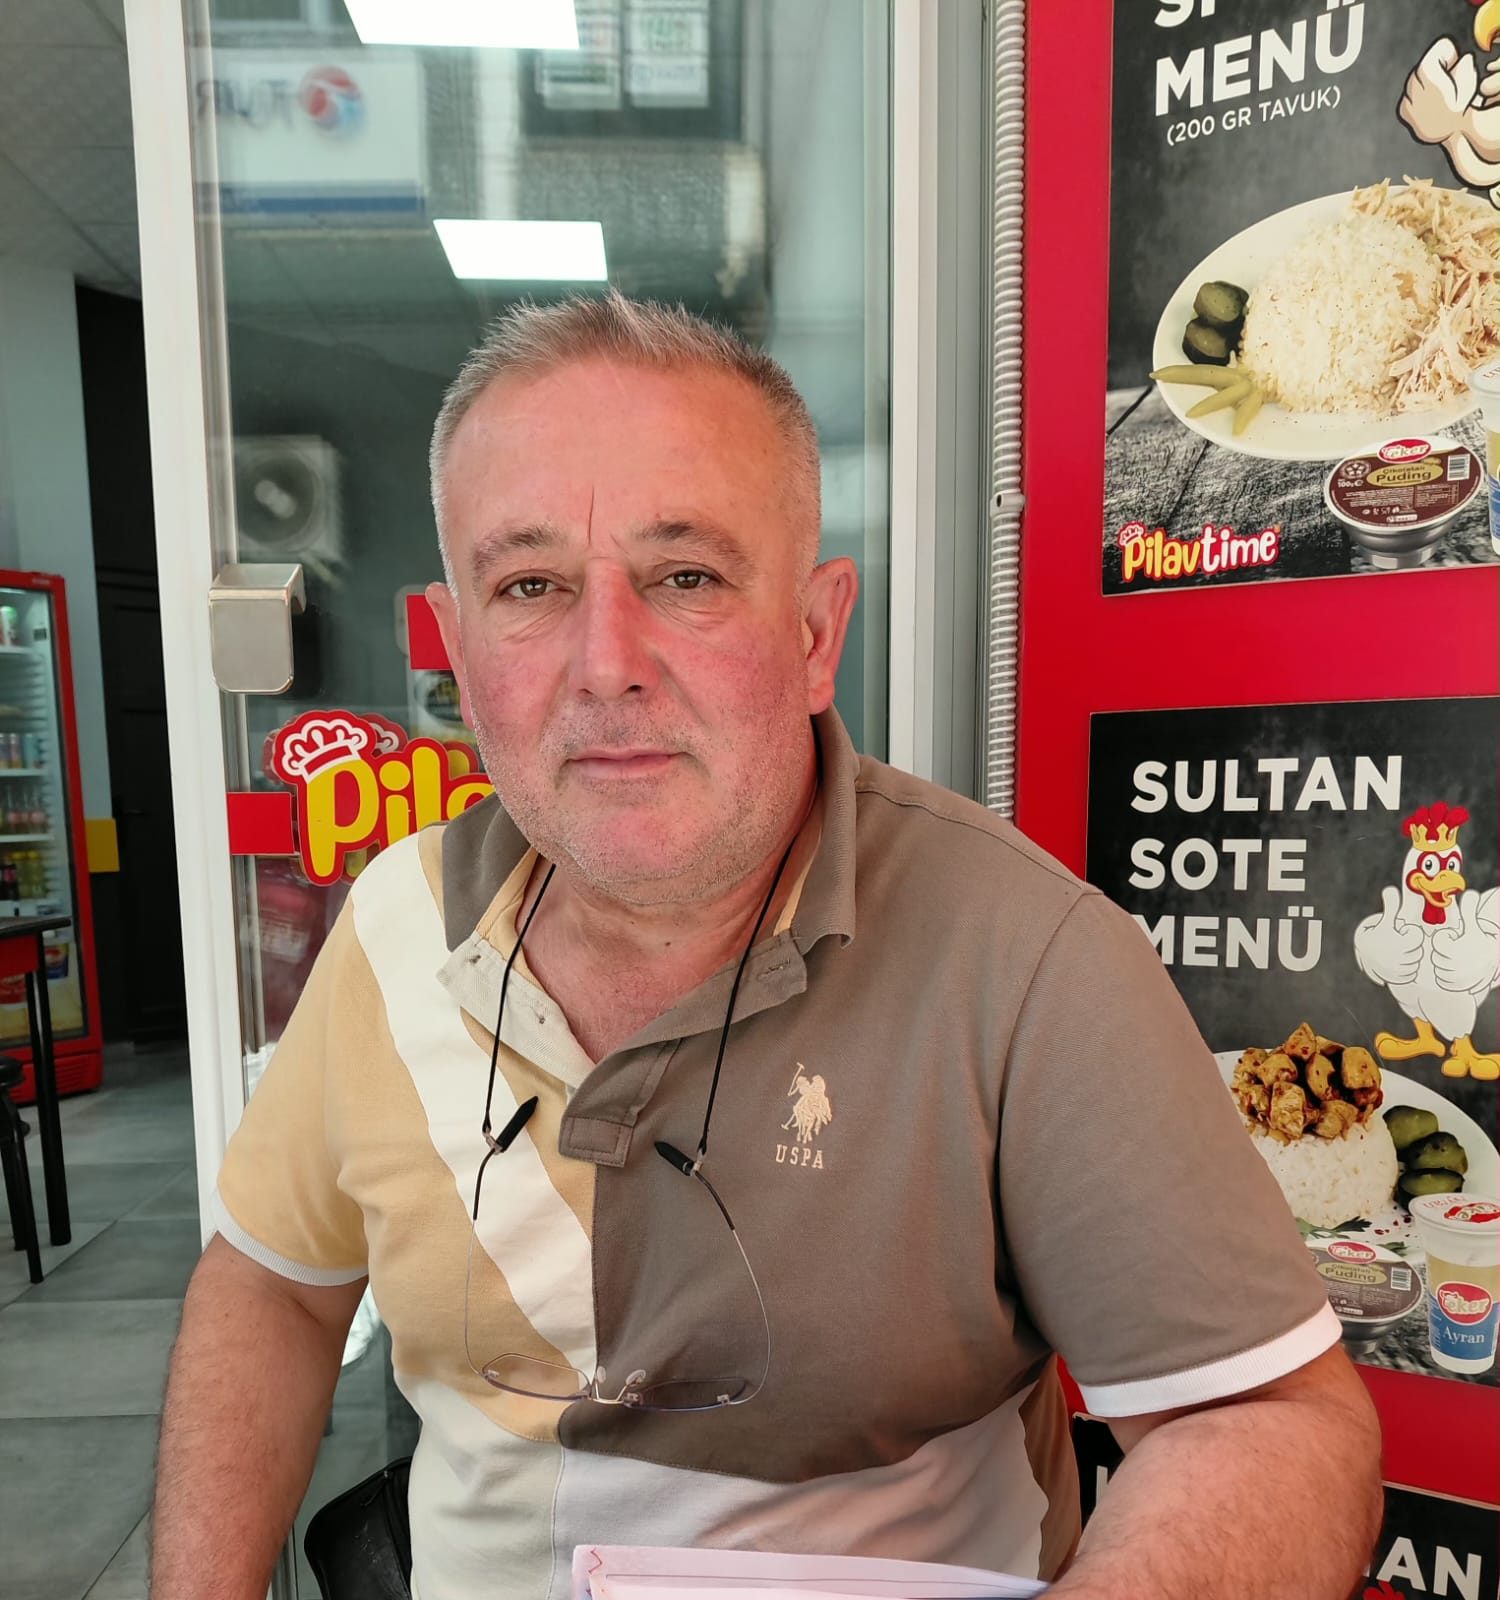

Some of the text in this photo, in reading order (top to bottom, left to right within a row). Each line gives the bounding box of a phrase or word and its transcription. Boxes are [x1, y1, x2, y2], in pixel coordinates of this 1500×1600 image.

[1155, 0, 1365, 117] MENÜ
[1166, 86, 1341, 146] (200 GR TAVUK)
[1376, 471, 1431, 483] Puding
[1130, 755, 1403, 813] SULTAN
[1128, 838, 1307, 891] SOTE
[775, 1143, 824, 1169] USPA
[1325, 1267, 1376, 1283] Puding
[1442, 1325, 1485, 1345] Ayran
[1364, 1535, 1483, 1600] AN
